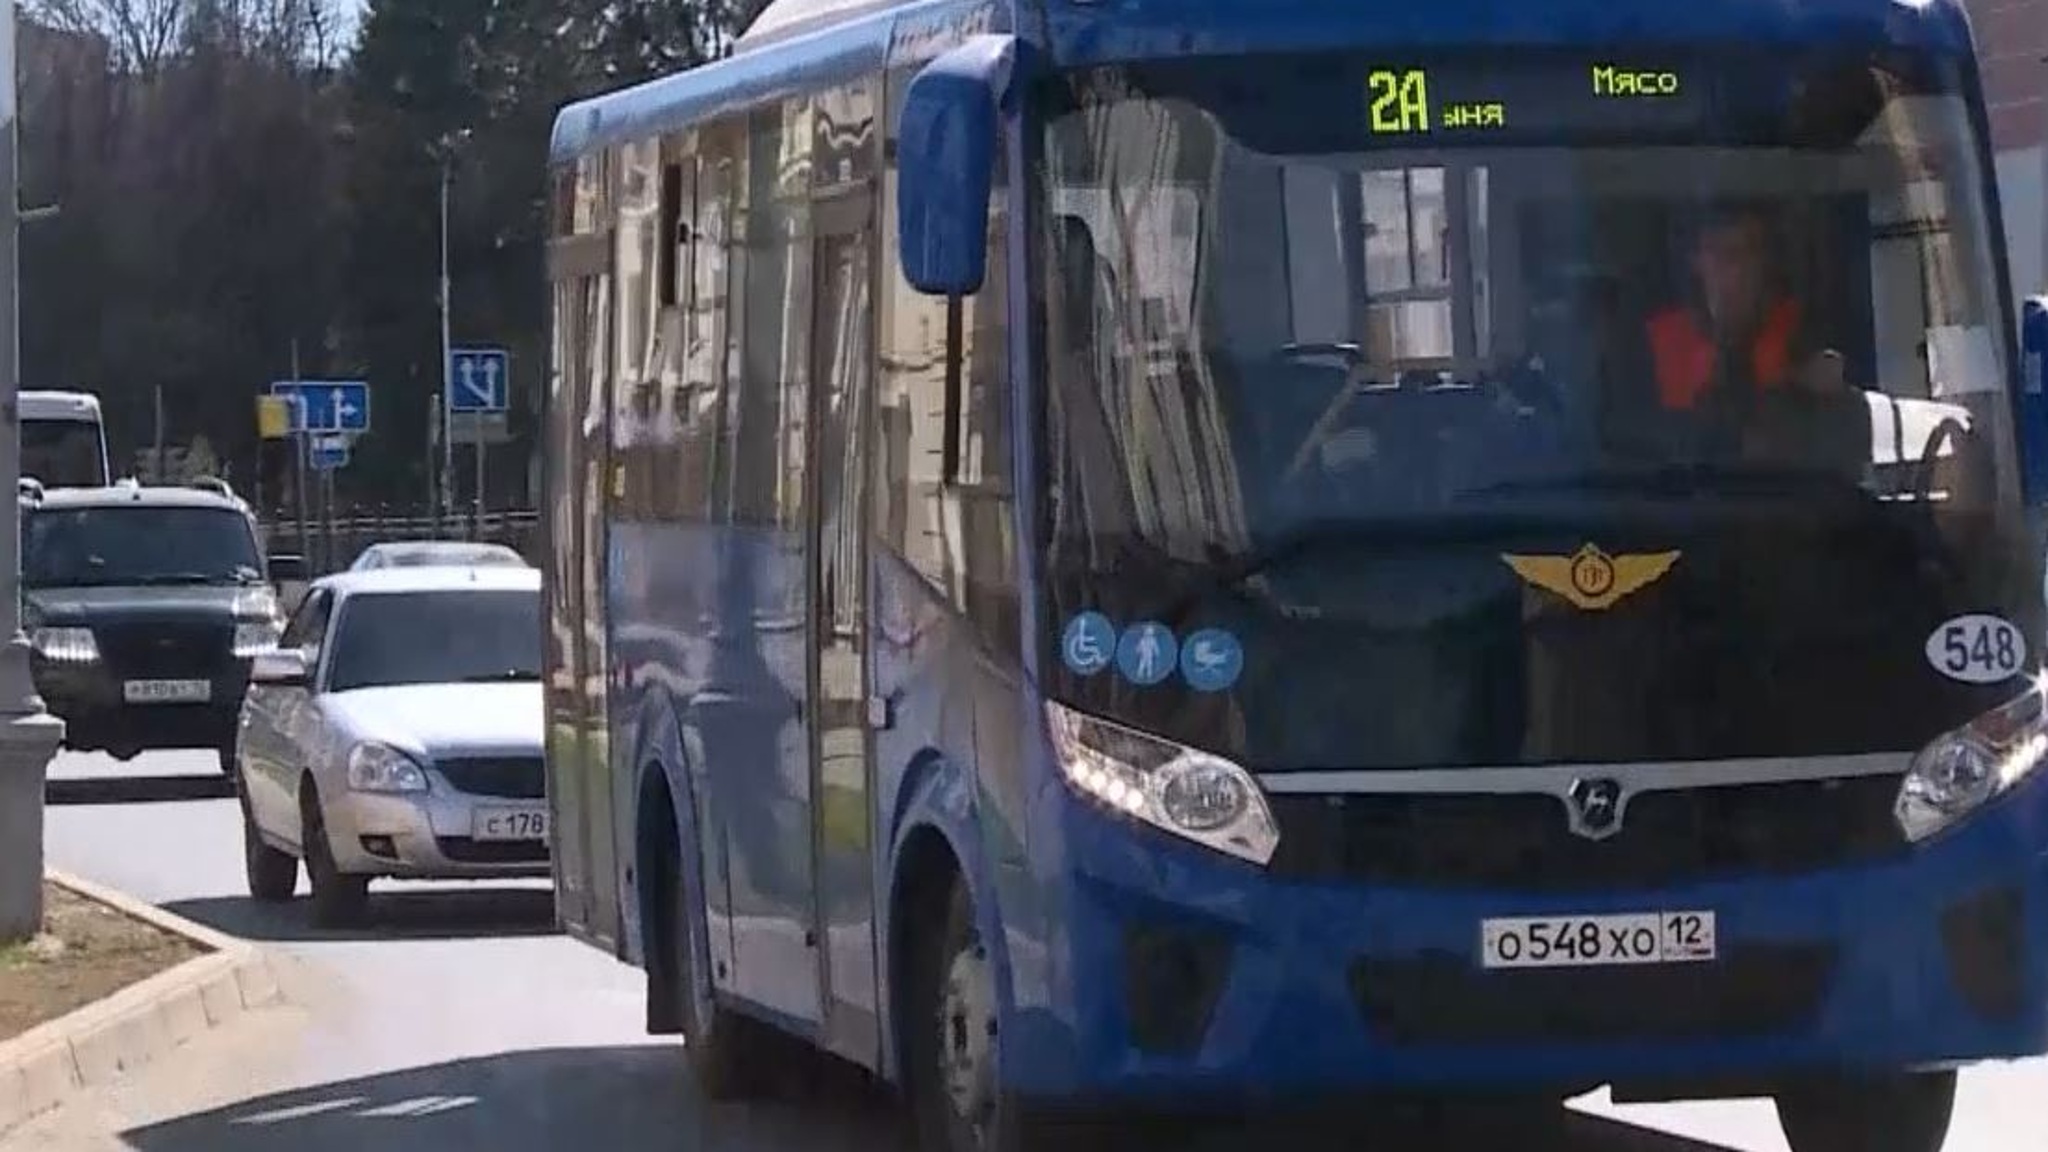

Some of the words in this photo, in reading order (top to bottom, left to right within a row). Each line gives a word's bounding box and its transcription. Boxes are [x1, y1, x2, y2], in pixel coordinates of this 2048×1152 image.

[1594, 66, 1678, 94] Мясо
[1369, 70, 1429, 131] 2А
[1945, 624, 2016, 672] 548
[1668, 916, 1701, 944] 12
